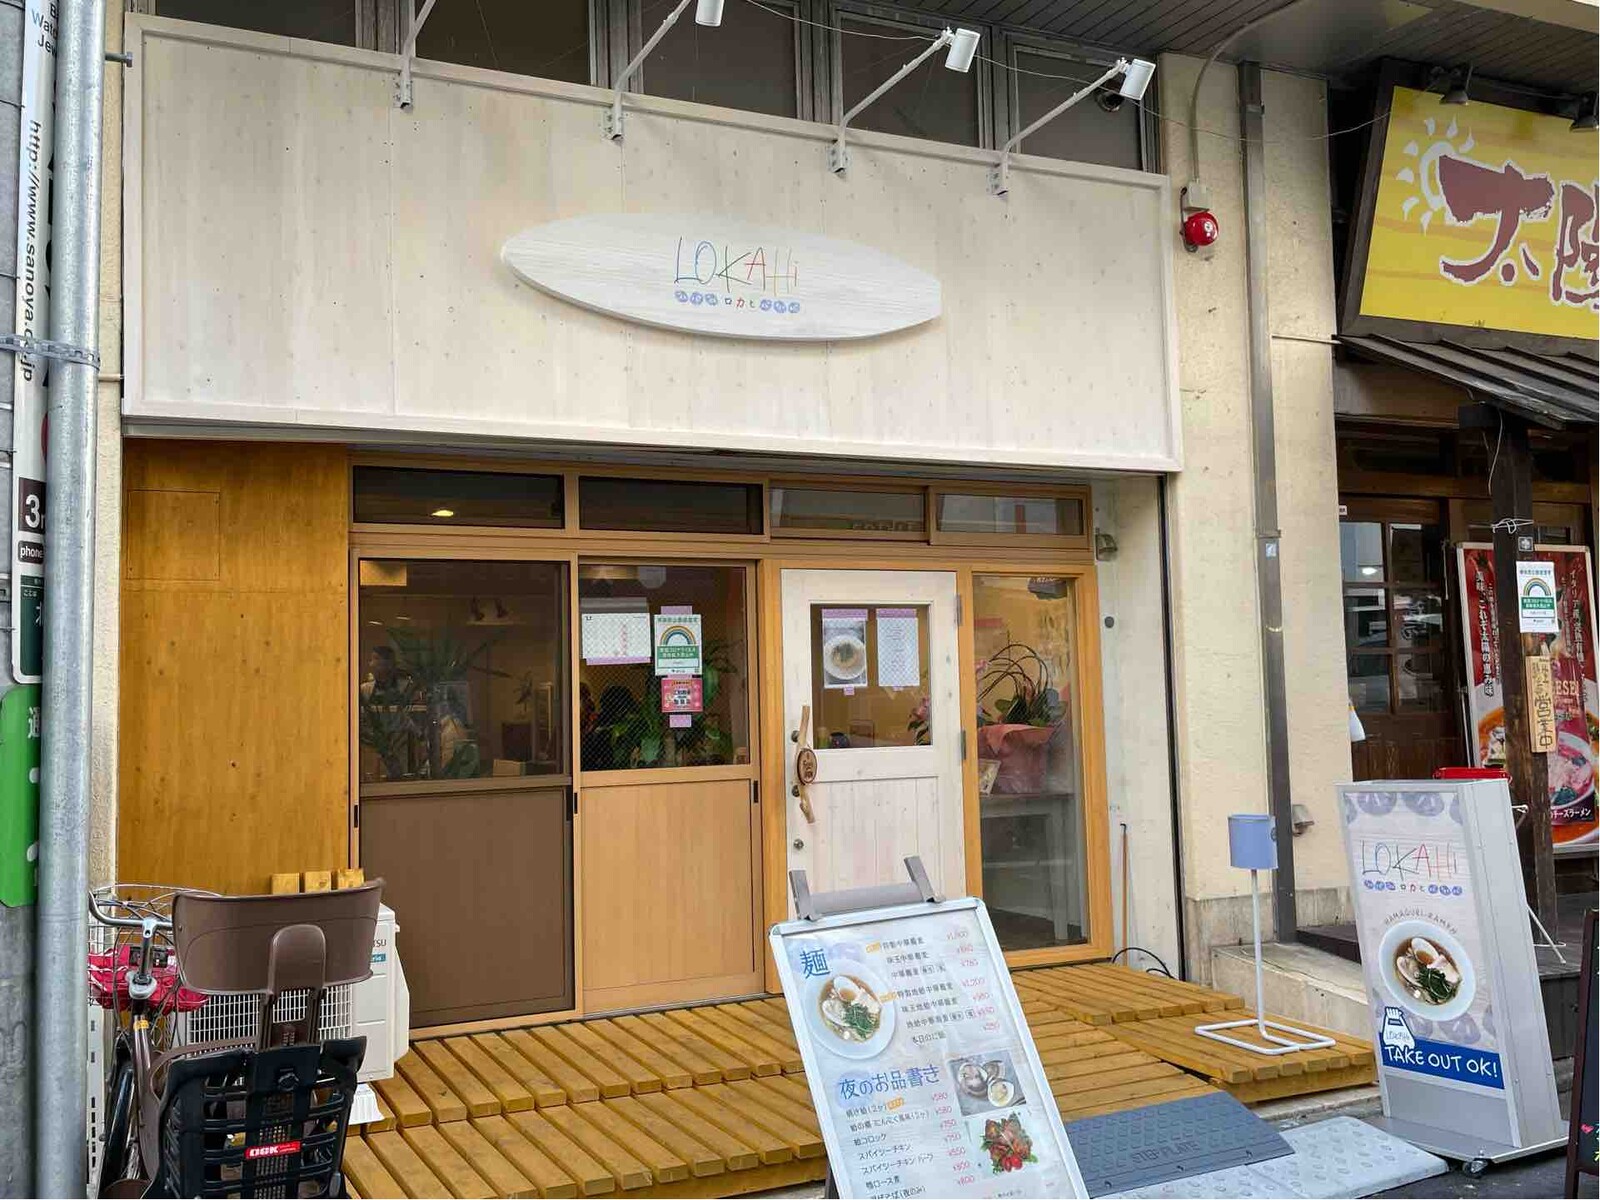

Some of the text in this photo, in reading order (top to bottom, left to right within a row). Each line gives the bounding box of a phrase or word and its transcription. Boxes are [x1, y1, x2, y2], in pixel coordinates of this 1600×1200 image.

[1384, 1046, 1498, 1078] TAKE OUT OK!
[840, 1064, 940, 1100] 夜のお品書き
